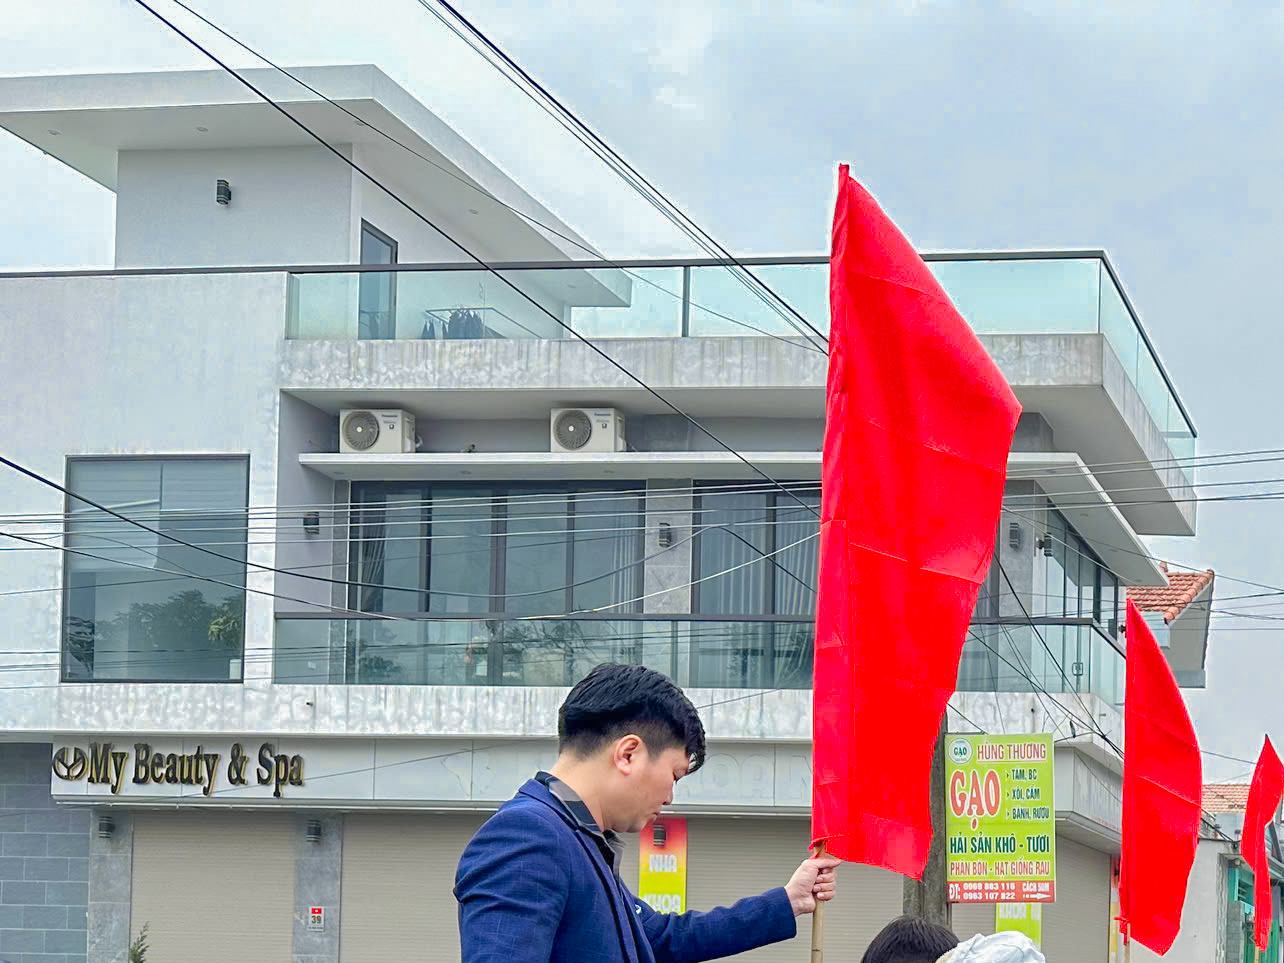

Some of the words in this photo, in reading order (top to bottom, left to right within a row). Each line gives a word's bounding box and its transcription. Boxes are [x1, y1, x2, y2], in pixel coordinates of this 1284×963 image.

[977, 742, 1004, 760] HÙNG
[1007, 743, 1046, 760] THƯƠNG
[88, 742, 129, 794] My
[132, 742, 222, 796] Beauty
[227, 743, 248, 785] &
[257, 742, 304, 797] Spa
[950, 769, 1001, 830] GẠO
[950, 831, 967, 853] HẢI
[971, 831, 992, 853] SẢN
[995, 832, 1016, 853] KHÔ
[1026, 834, 1050, 853] TƯƠI
[1035, 861, 1050, 876] RAU
[311, 915, 322, 924] 39
